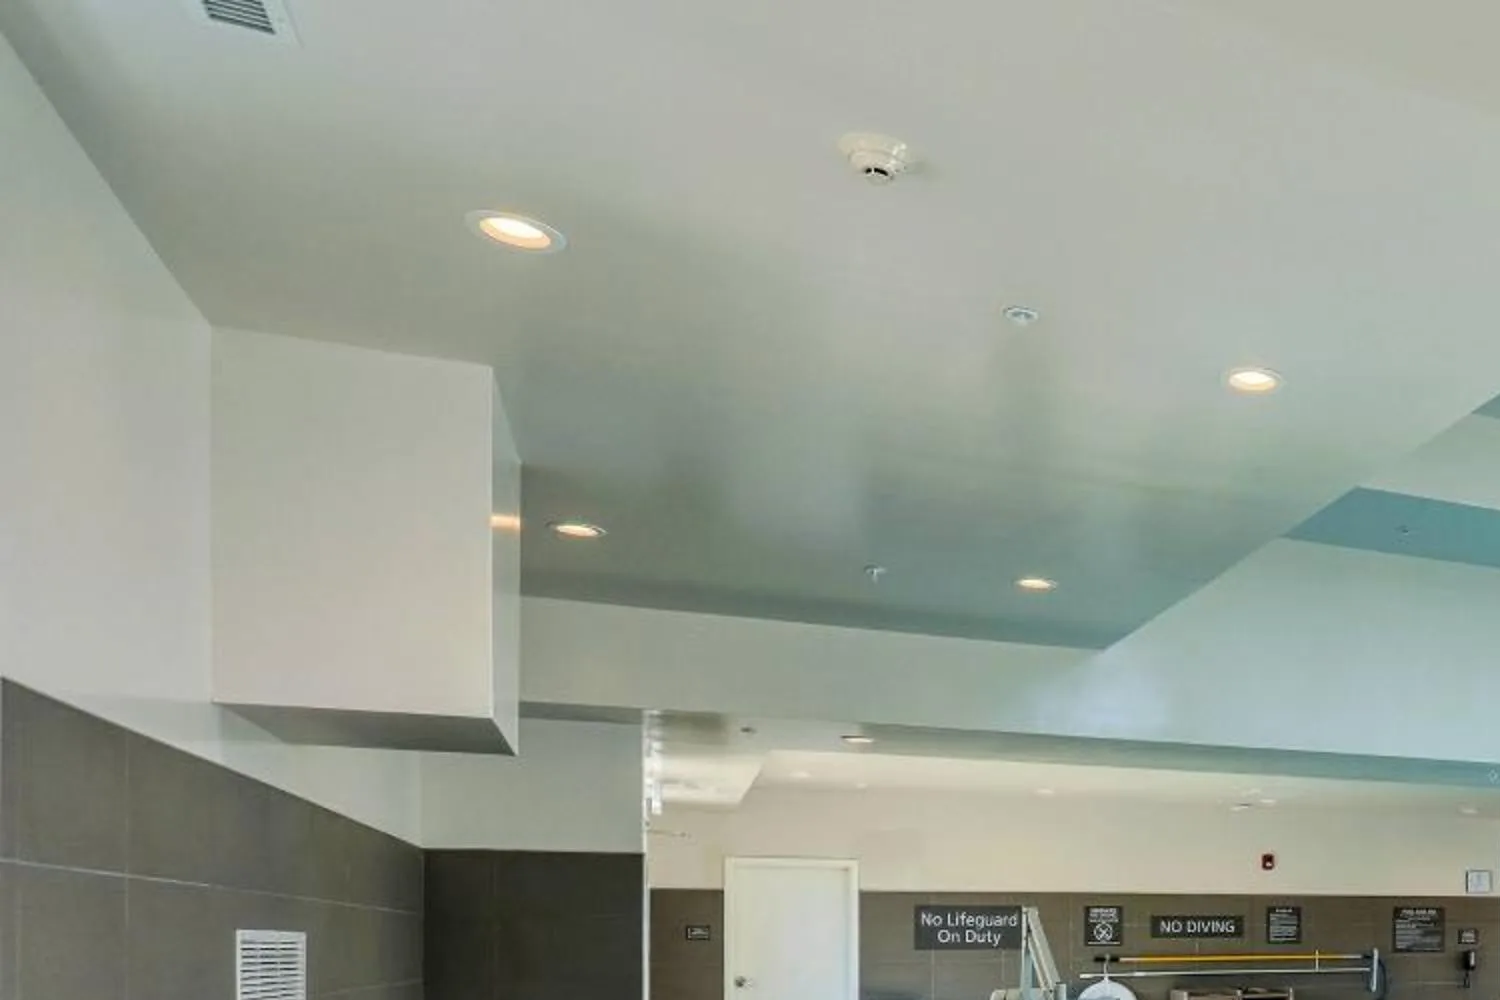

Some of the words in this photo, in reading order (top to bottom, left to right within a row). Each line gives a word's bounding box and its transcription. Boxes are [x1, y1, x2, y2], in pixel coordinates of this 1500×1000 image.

[920, 911, 943, 927] No
[947, 911, 1019, 931] Lifeguard
[1160, 919, 1183, 933] NO
[1187, 919, 1236, 933] DIVING
[937, 929, 961, 943] On
[965, 929, 1001, 947] Duty
